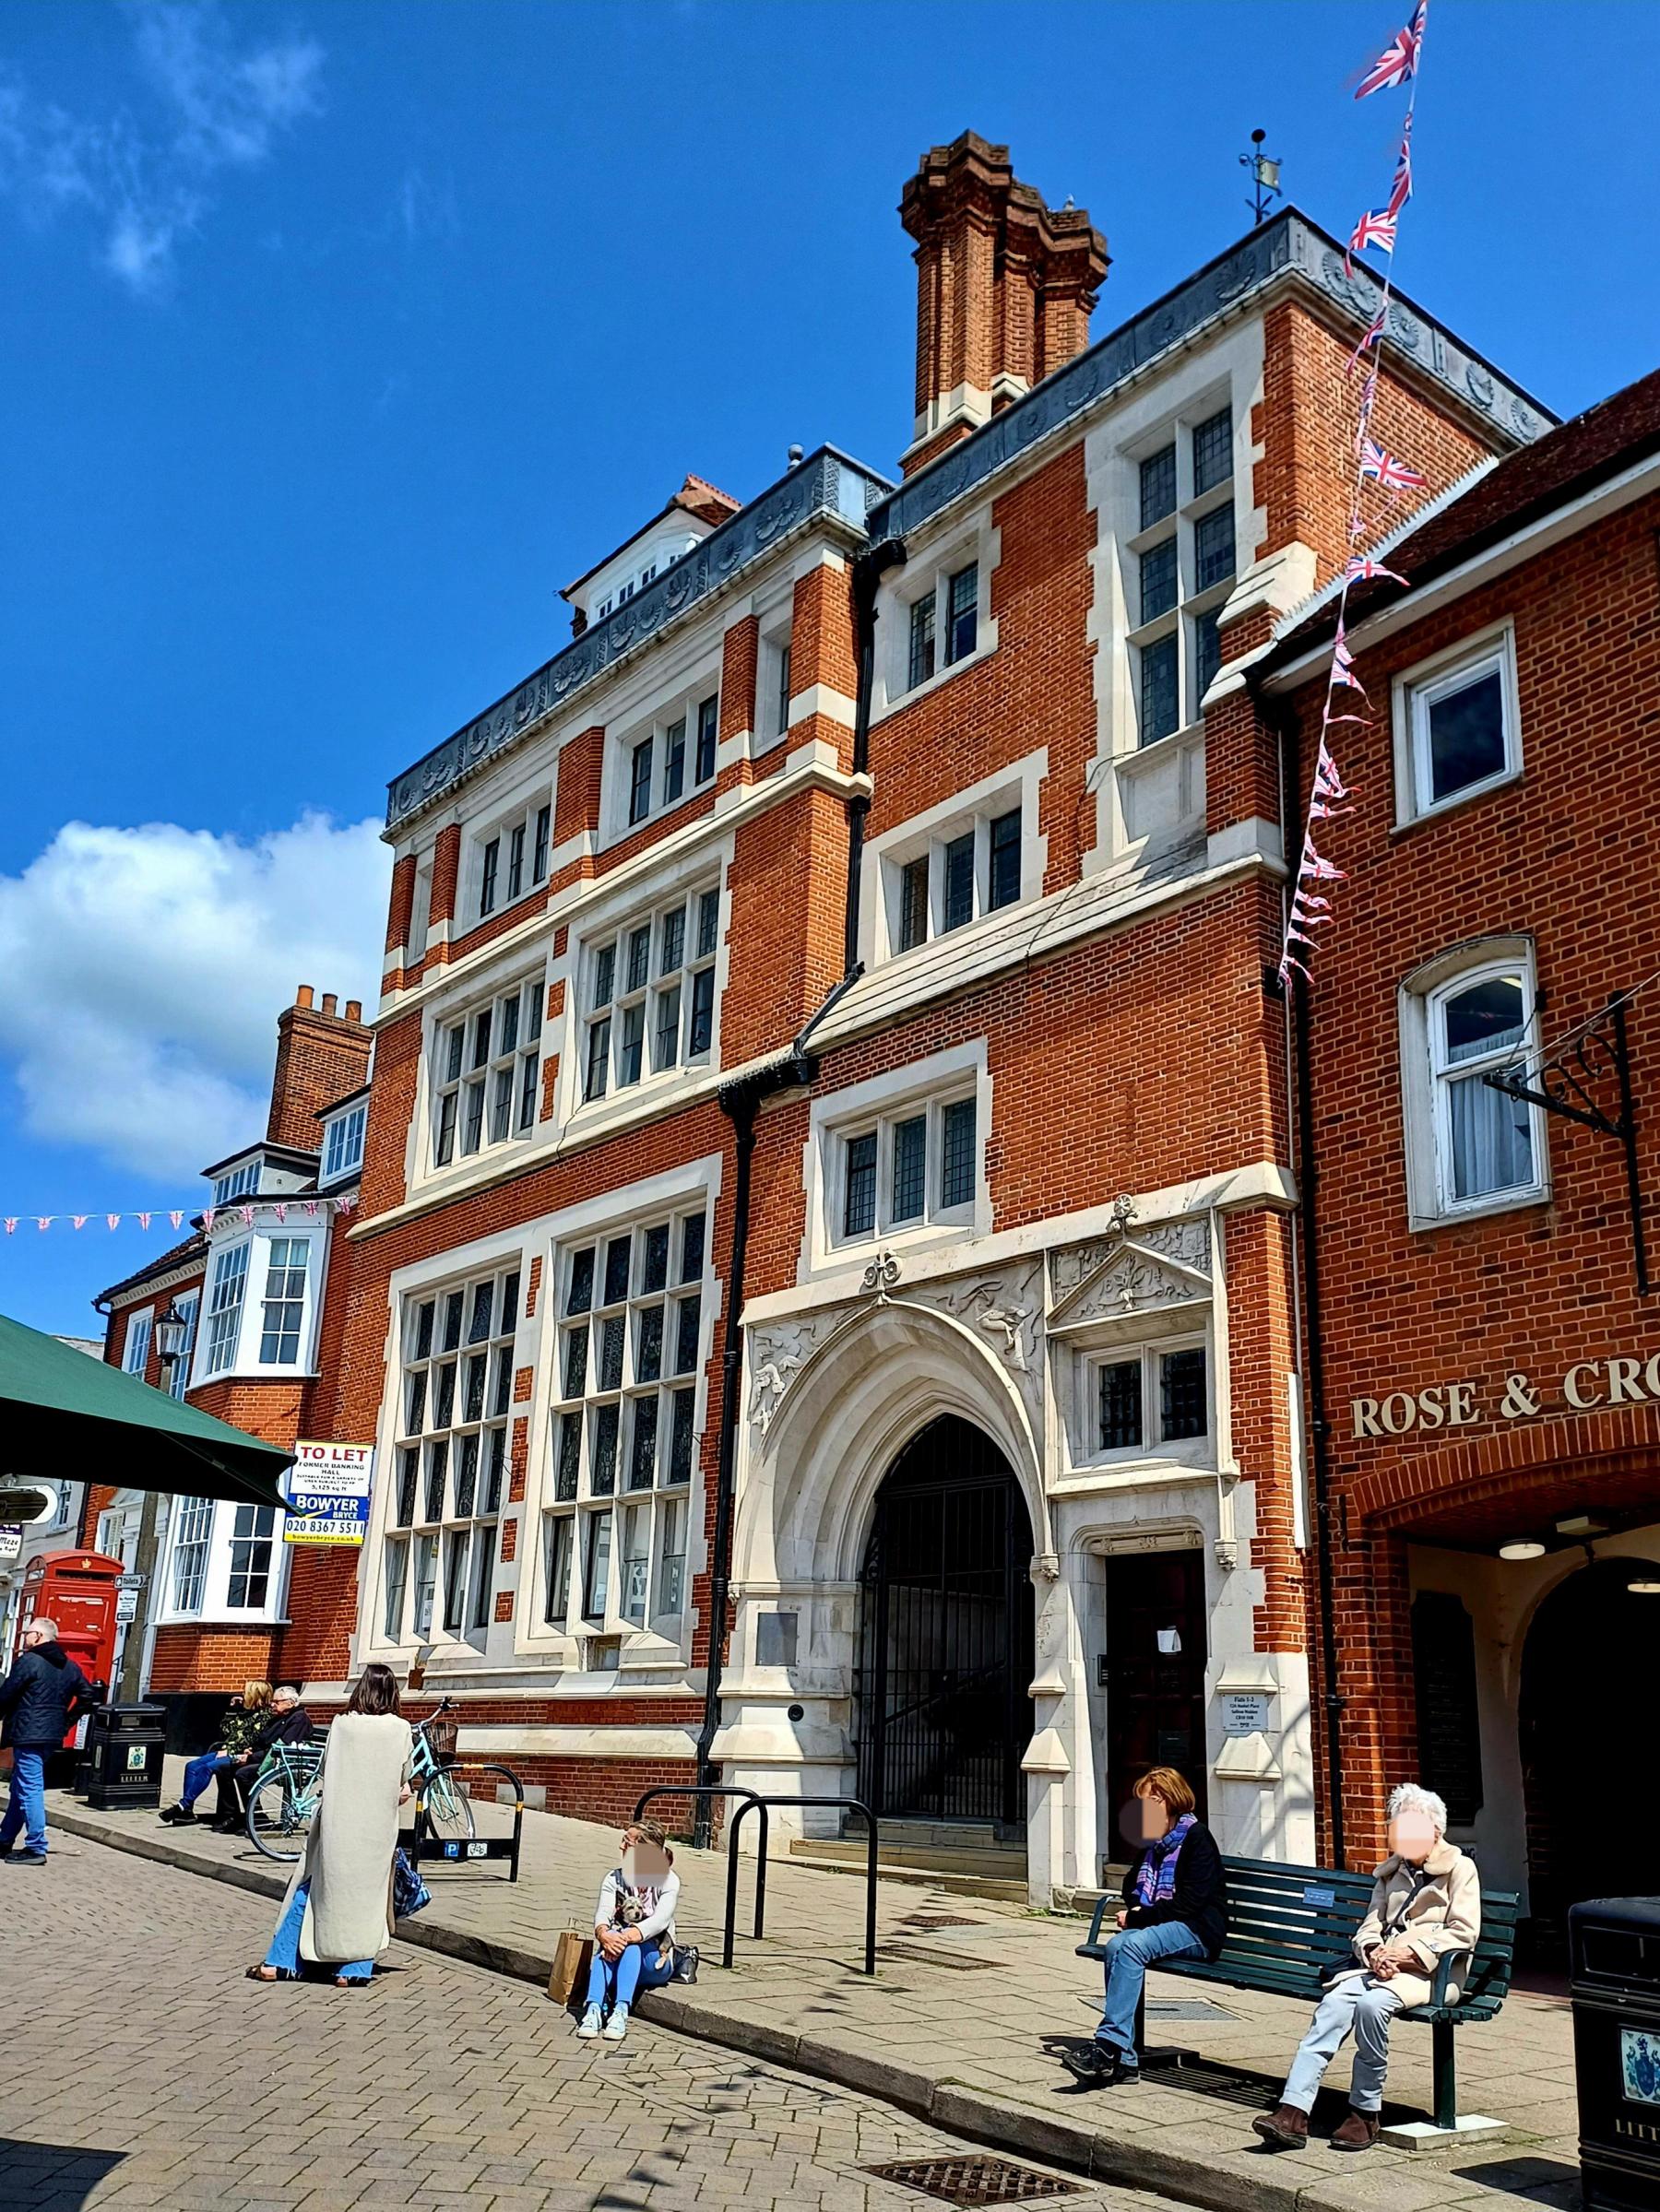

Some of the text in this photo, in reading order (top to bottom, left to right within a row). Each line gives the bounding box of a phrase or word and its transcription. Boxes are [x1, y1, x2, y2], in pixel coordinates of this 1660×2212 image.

[1349, 1382, 1480, 1438] ROSE
[1500, 1374, 1541, 1418] &
[301, 1447, 368, 1461] TO LET
[296, 1495, 360, 1511] BOWYER
[333, 1511, 358, 1520] BRYCE
[287, 1520, 363, 1534] 020 8367 5511
